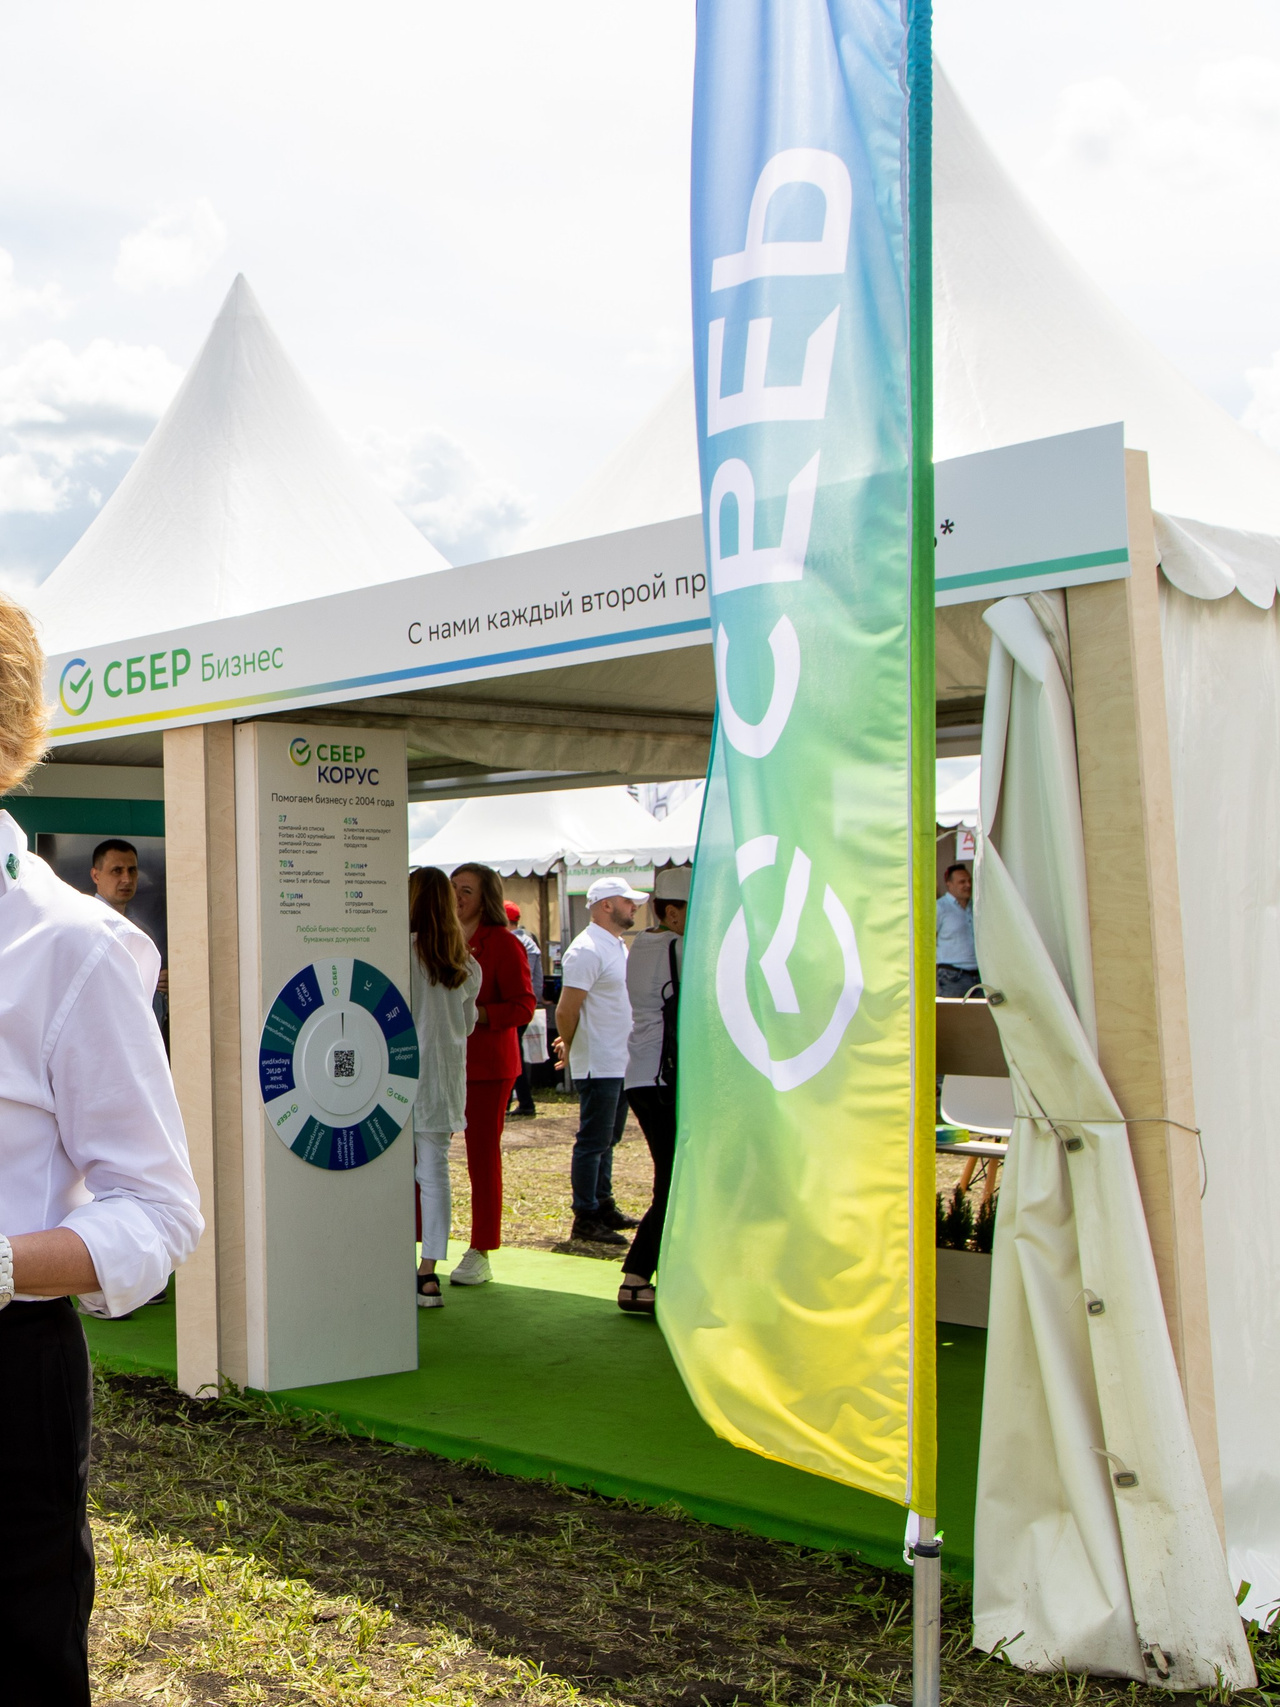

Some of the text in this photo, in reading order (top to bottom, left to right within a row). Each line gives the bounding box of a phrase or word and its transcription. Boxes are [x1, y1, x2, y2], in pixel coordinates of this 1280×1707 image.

[408, 622, 422, 645] С
[428, 616, 480, 642] нами
[486, 590, 573, 631] каждый
[580, 572, 666, 612] второй
[103, 647, 284, 698] СБЕР Бизнес
[316, 743, 366, 763] СБЕР
[317, 765, 380, 786] КОРУС
[271, 792, 395, 808] Помогаем бизнесу с 2004 года
[344, 861, 349, 869] 2
[280, 891, 285, 899] 4
[295, 924, 377, 934] Любой бизнес-процесс без
[303, 935, 370, 944] бумажных документов
[385, 1006, 401, 1022] ЭЦП
[261, 1058, 290, 1067] Меркурий
[394, 1053, 414, 1061] оборот
[264, 1083, 289, 1092] Честный
[393, 1092, 409, 1104] СБЕР
[276, 1110, 292, 1127] СБЕР
[309, 1128, 325, 1161] Проверка
